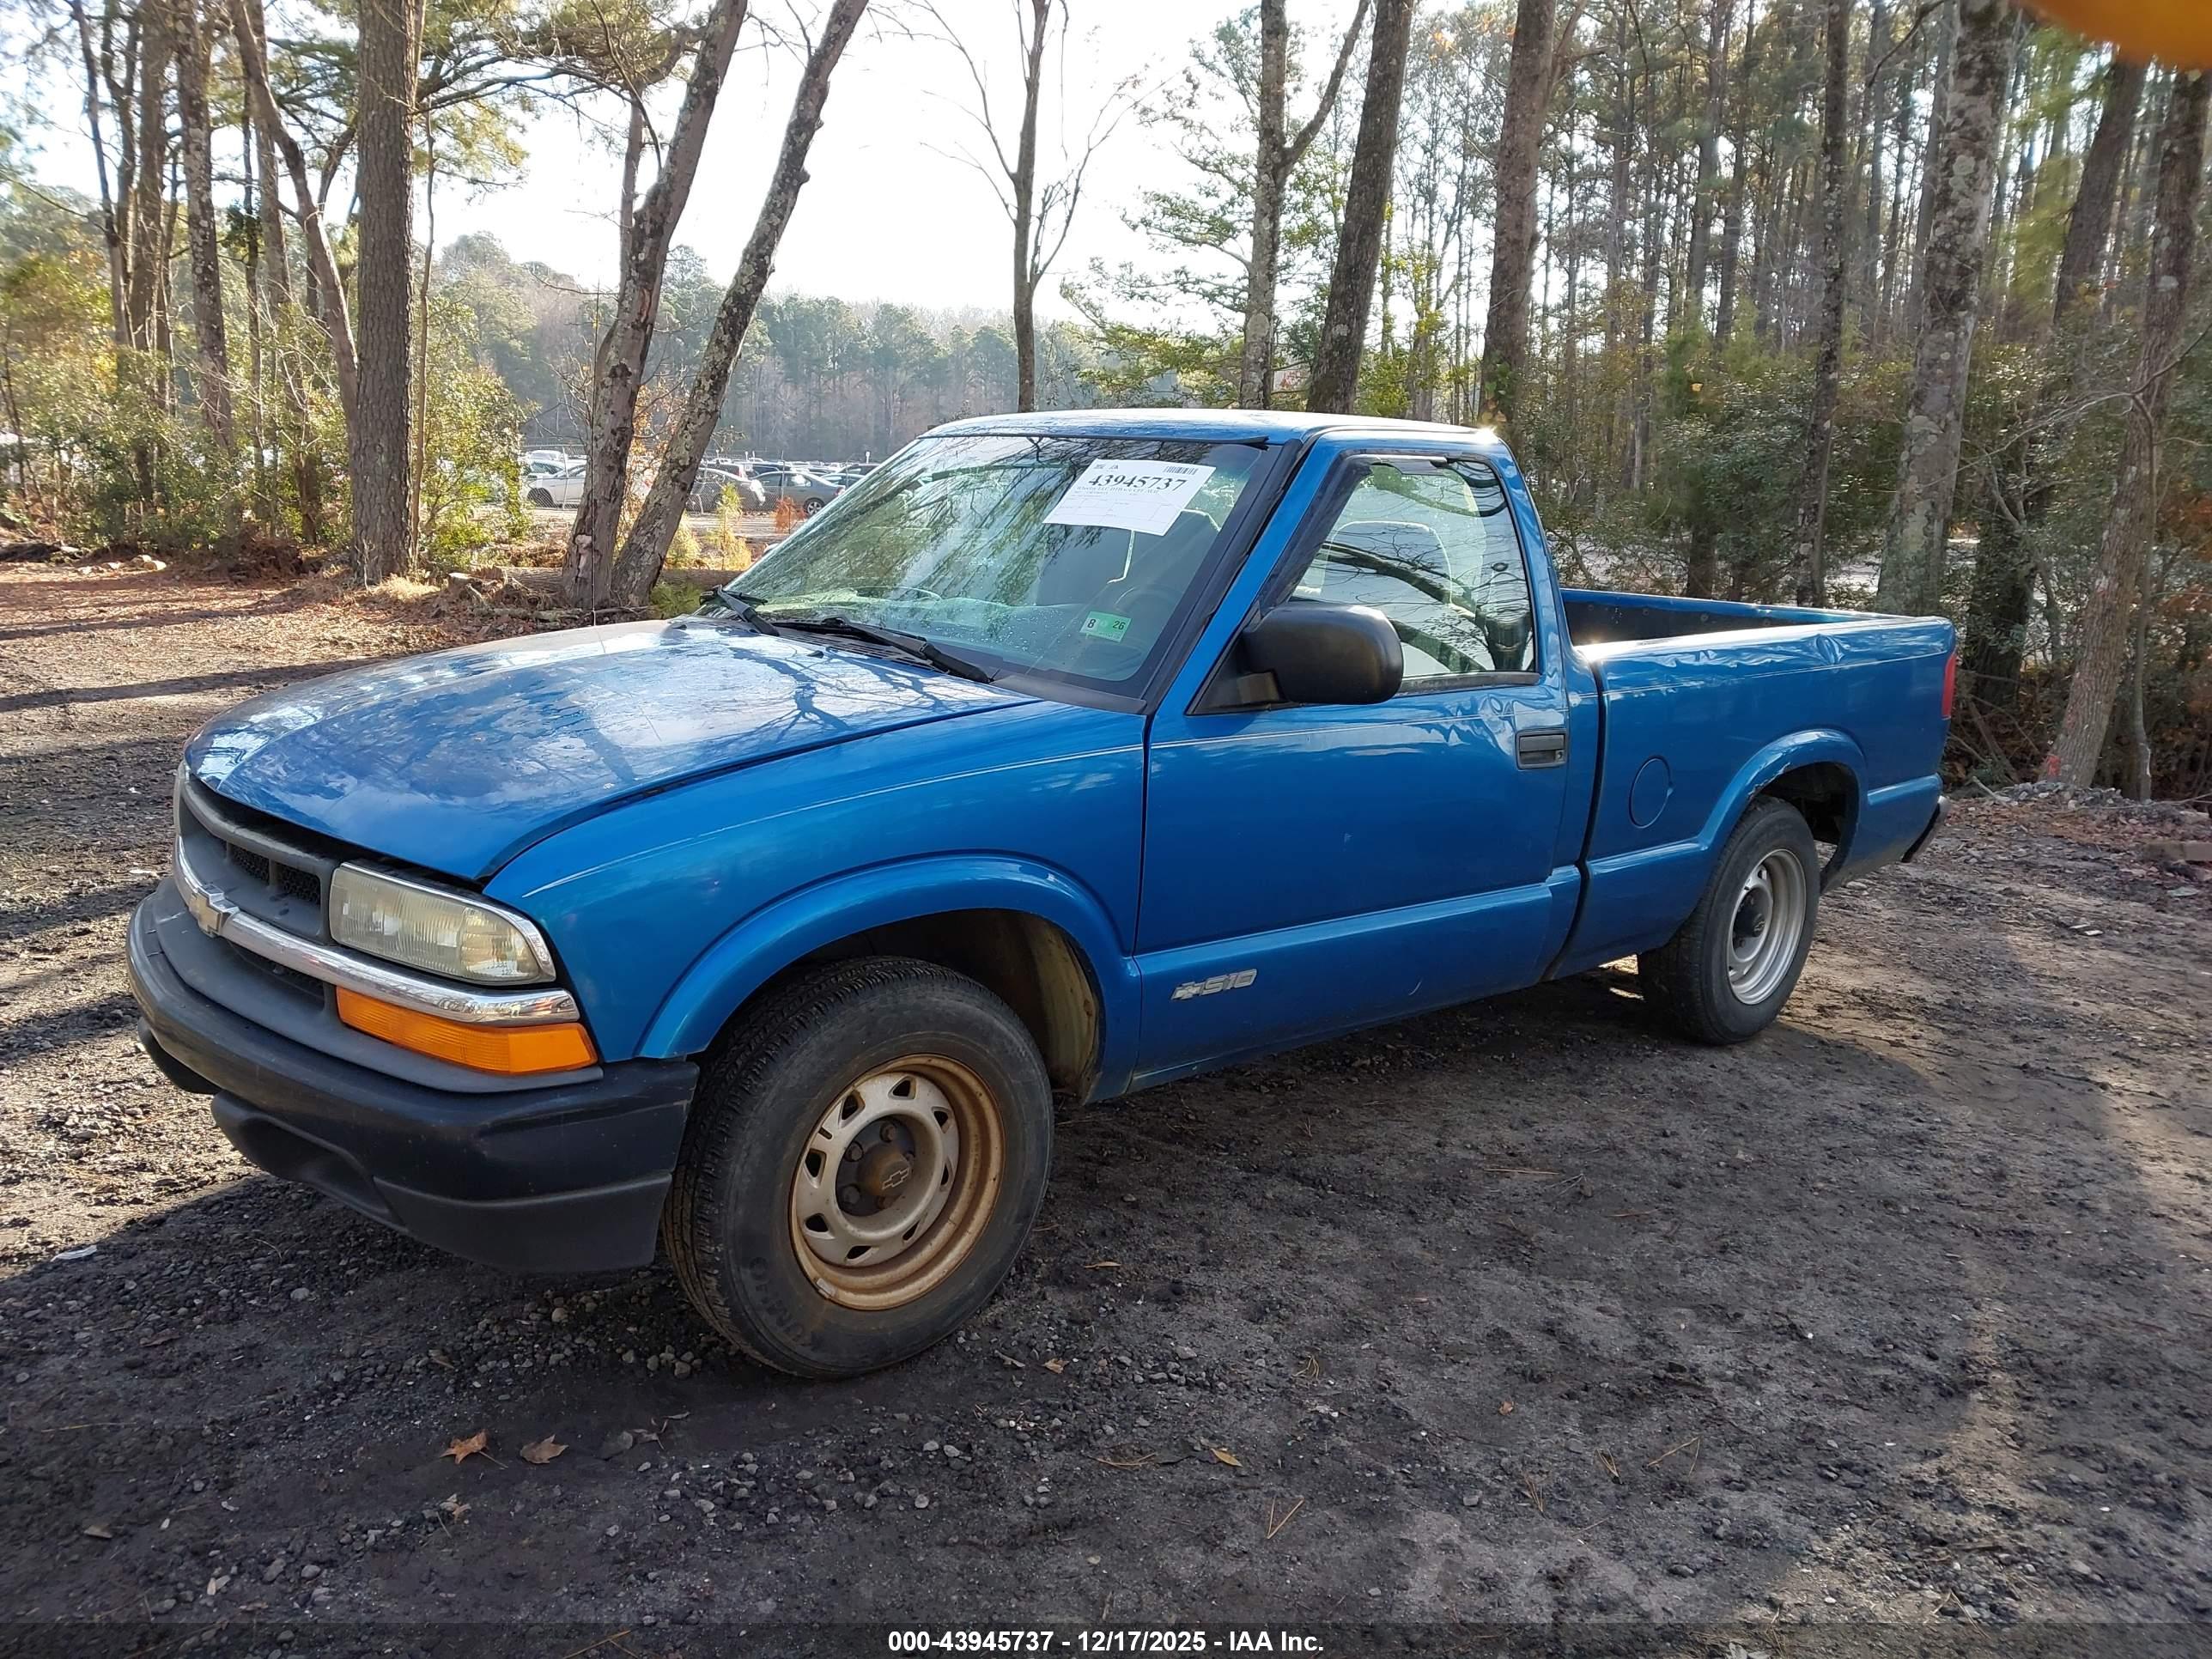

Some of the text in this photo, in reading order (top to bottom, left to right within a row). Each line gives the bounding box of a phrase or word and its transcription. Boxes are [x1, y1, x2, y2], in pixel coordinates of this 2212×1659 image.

[1088, 474, 1188, 492] 43945737
[1087, 618, 1097, 629] 8
[1112, 620, 1127, 630] 26
